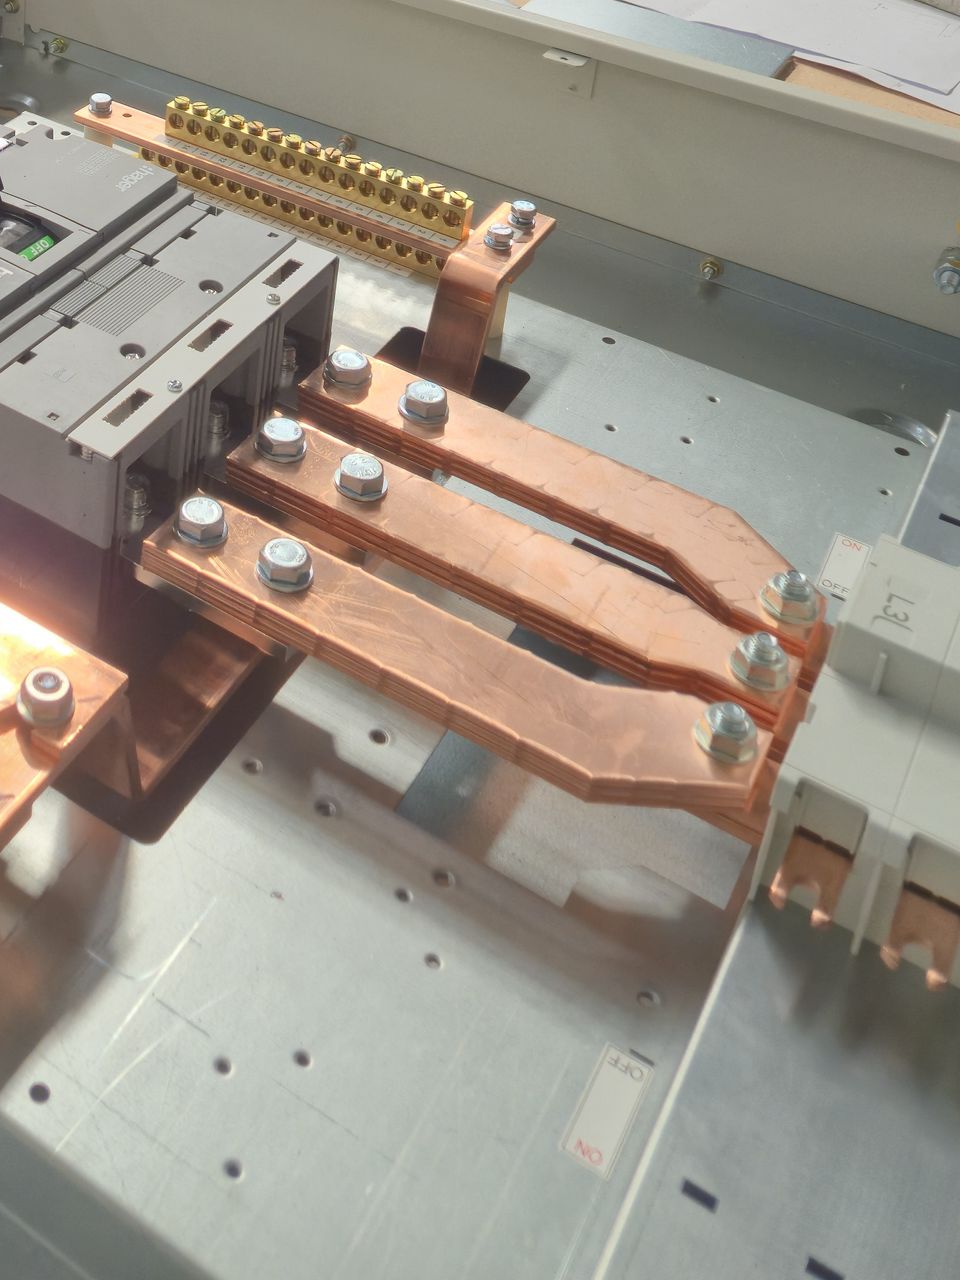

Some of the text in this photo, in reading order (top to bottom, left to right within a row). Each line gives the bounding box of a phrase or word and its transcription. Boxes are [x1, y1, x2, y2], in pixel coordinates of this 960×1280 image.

[115, 166, 154, 192] hager
[31, 238, 49, 255] OFF
[841, 539, 862, 552] ON
[821, 579, 849, 596] OFF
[607, 1056, 644, 1081] OFF
[576, 1138, 603, 1165] ON
